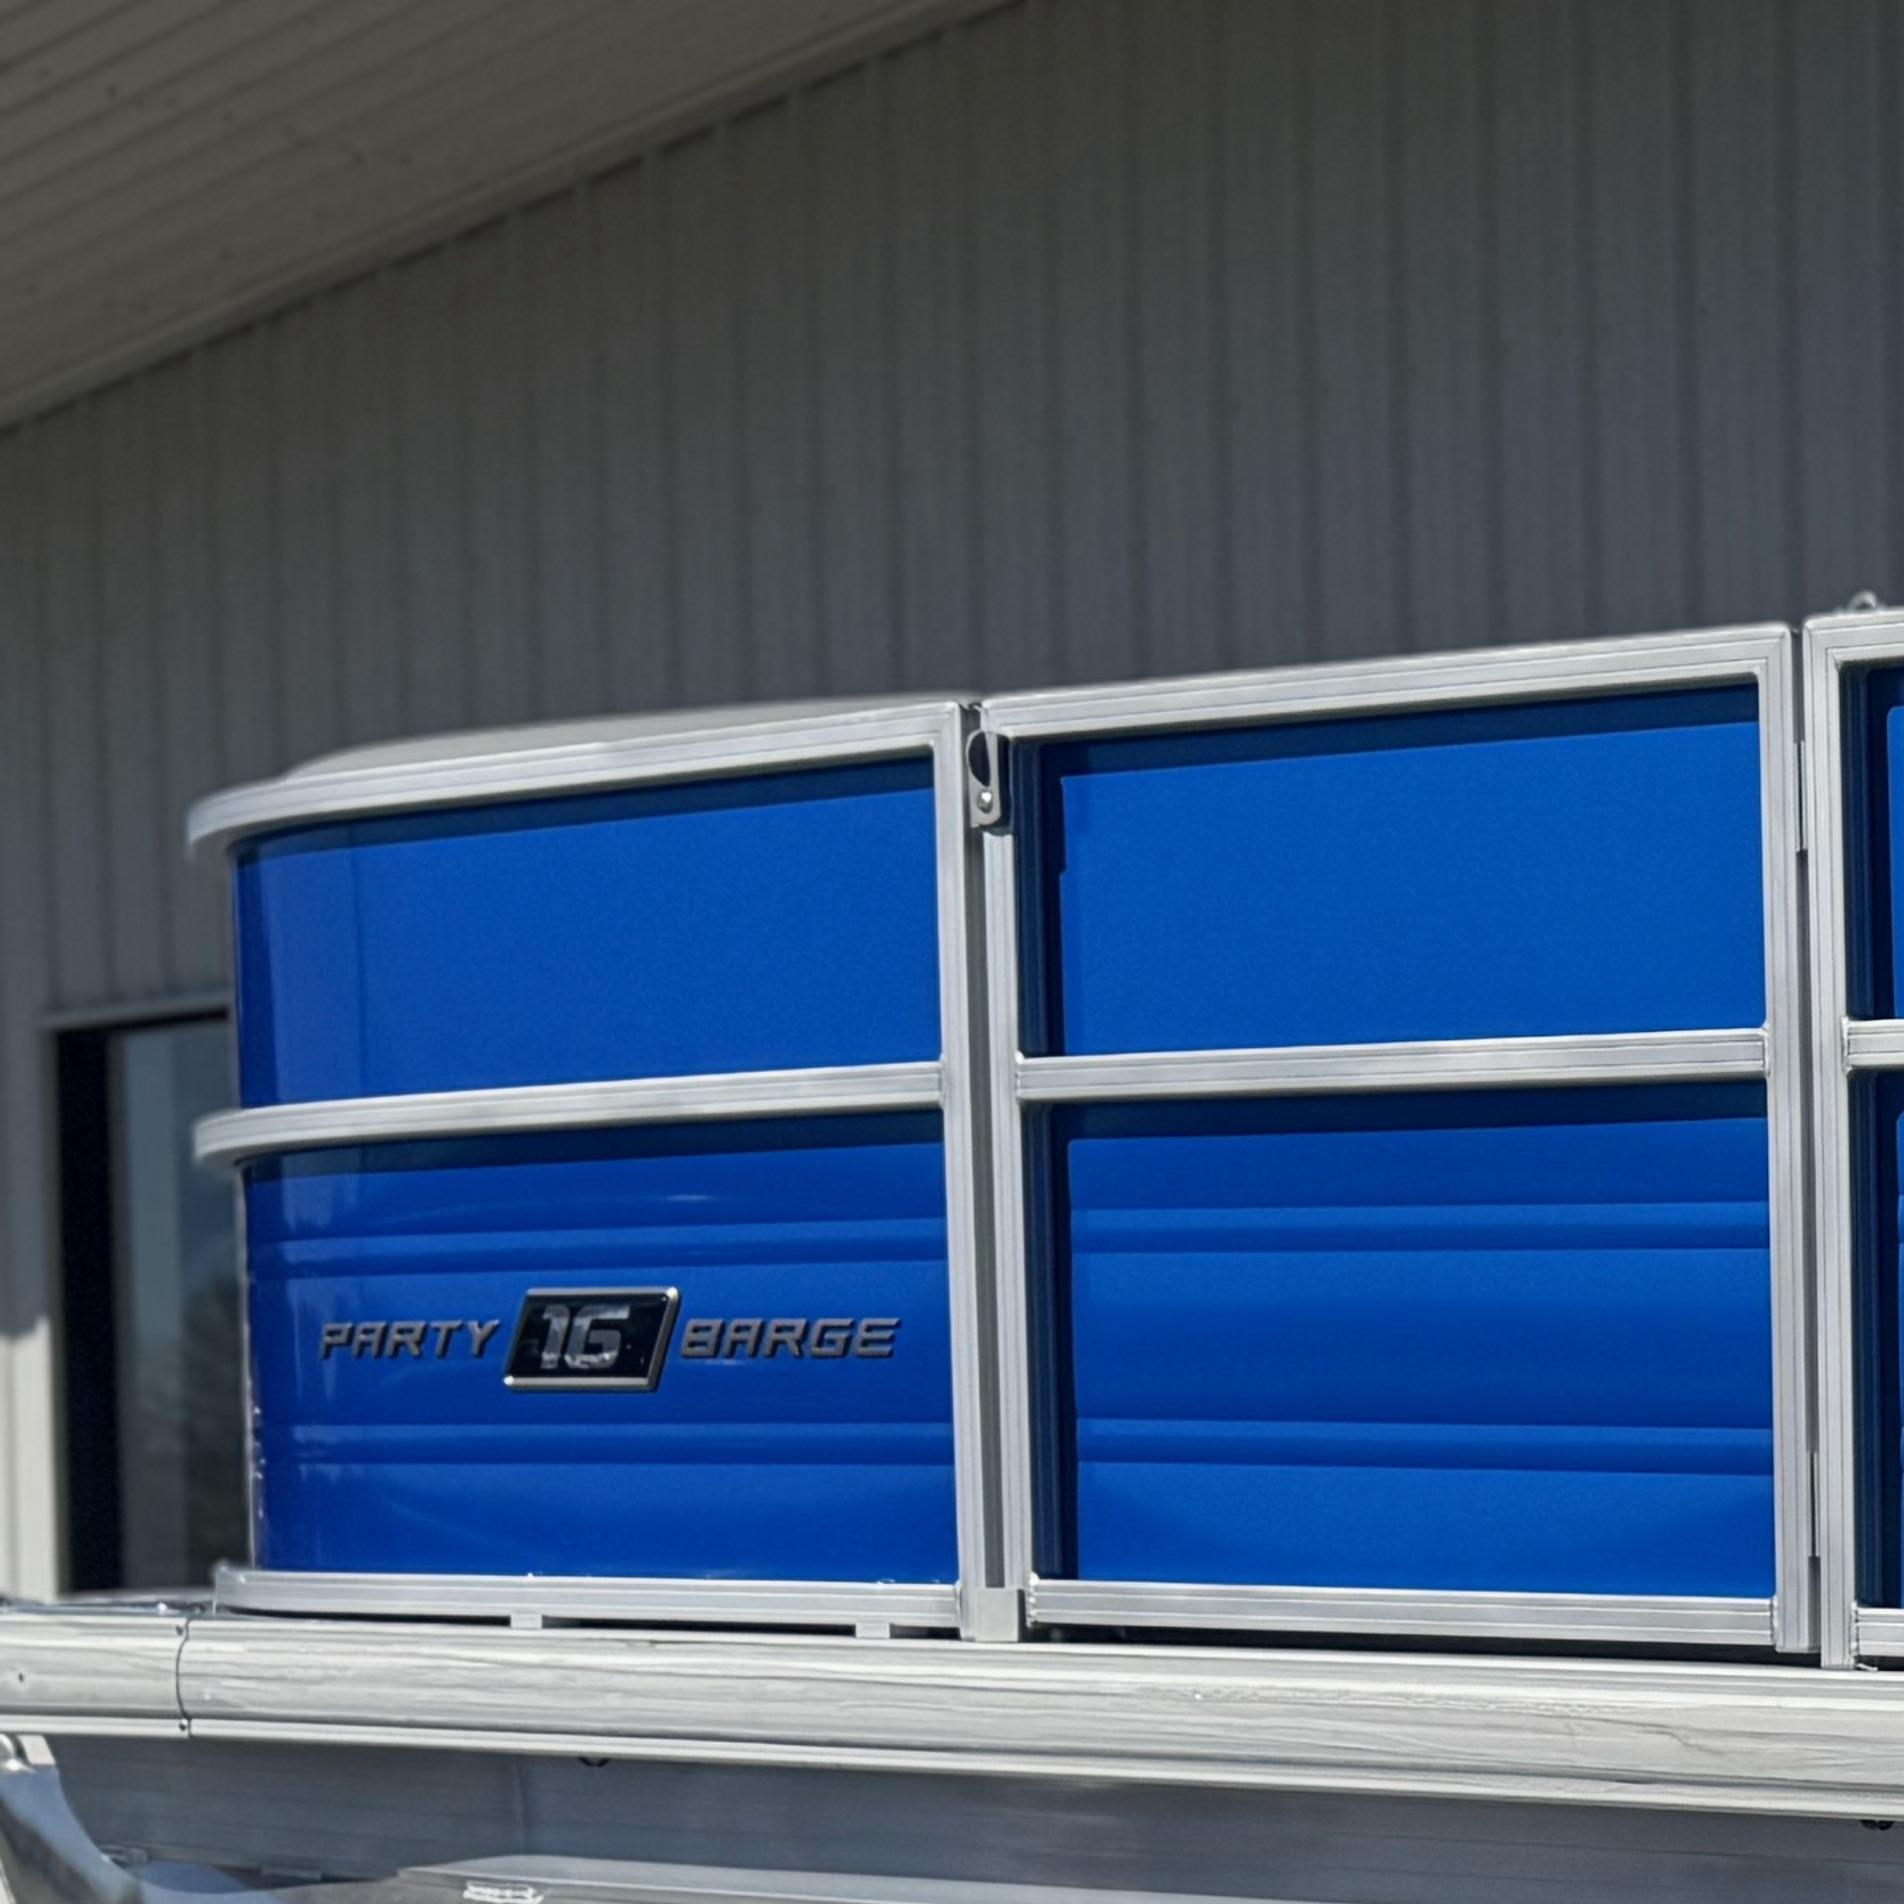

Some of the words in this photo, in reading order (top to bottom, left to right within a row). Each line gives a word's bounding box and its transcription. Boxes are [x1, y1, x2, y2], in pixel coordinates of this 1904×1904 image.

[319, 1318, 501, 1361] PARTY
[538, 1302, 630, 1371] 16
[679, 1316, 903, 1360] BARGE
